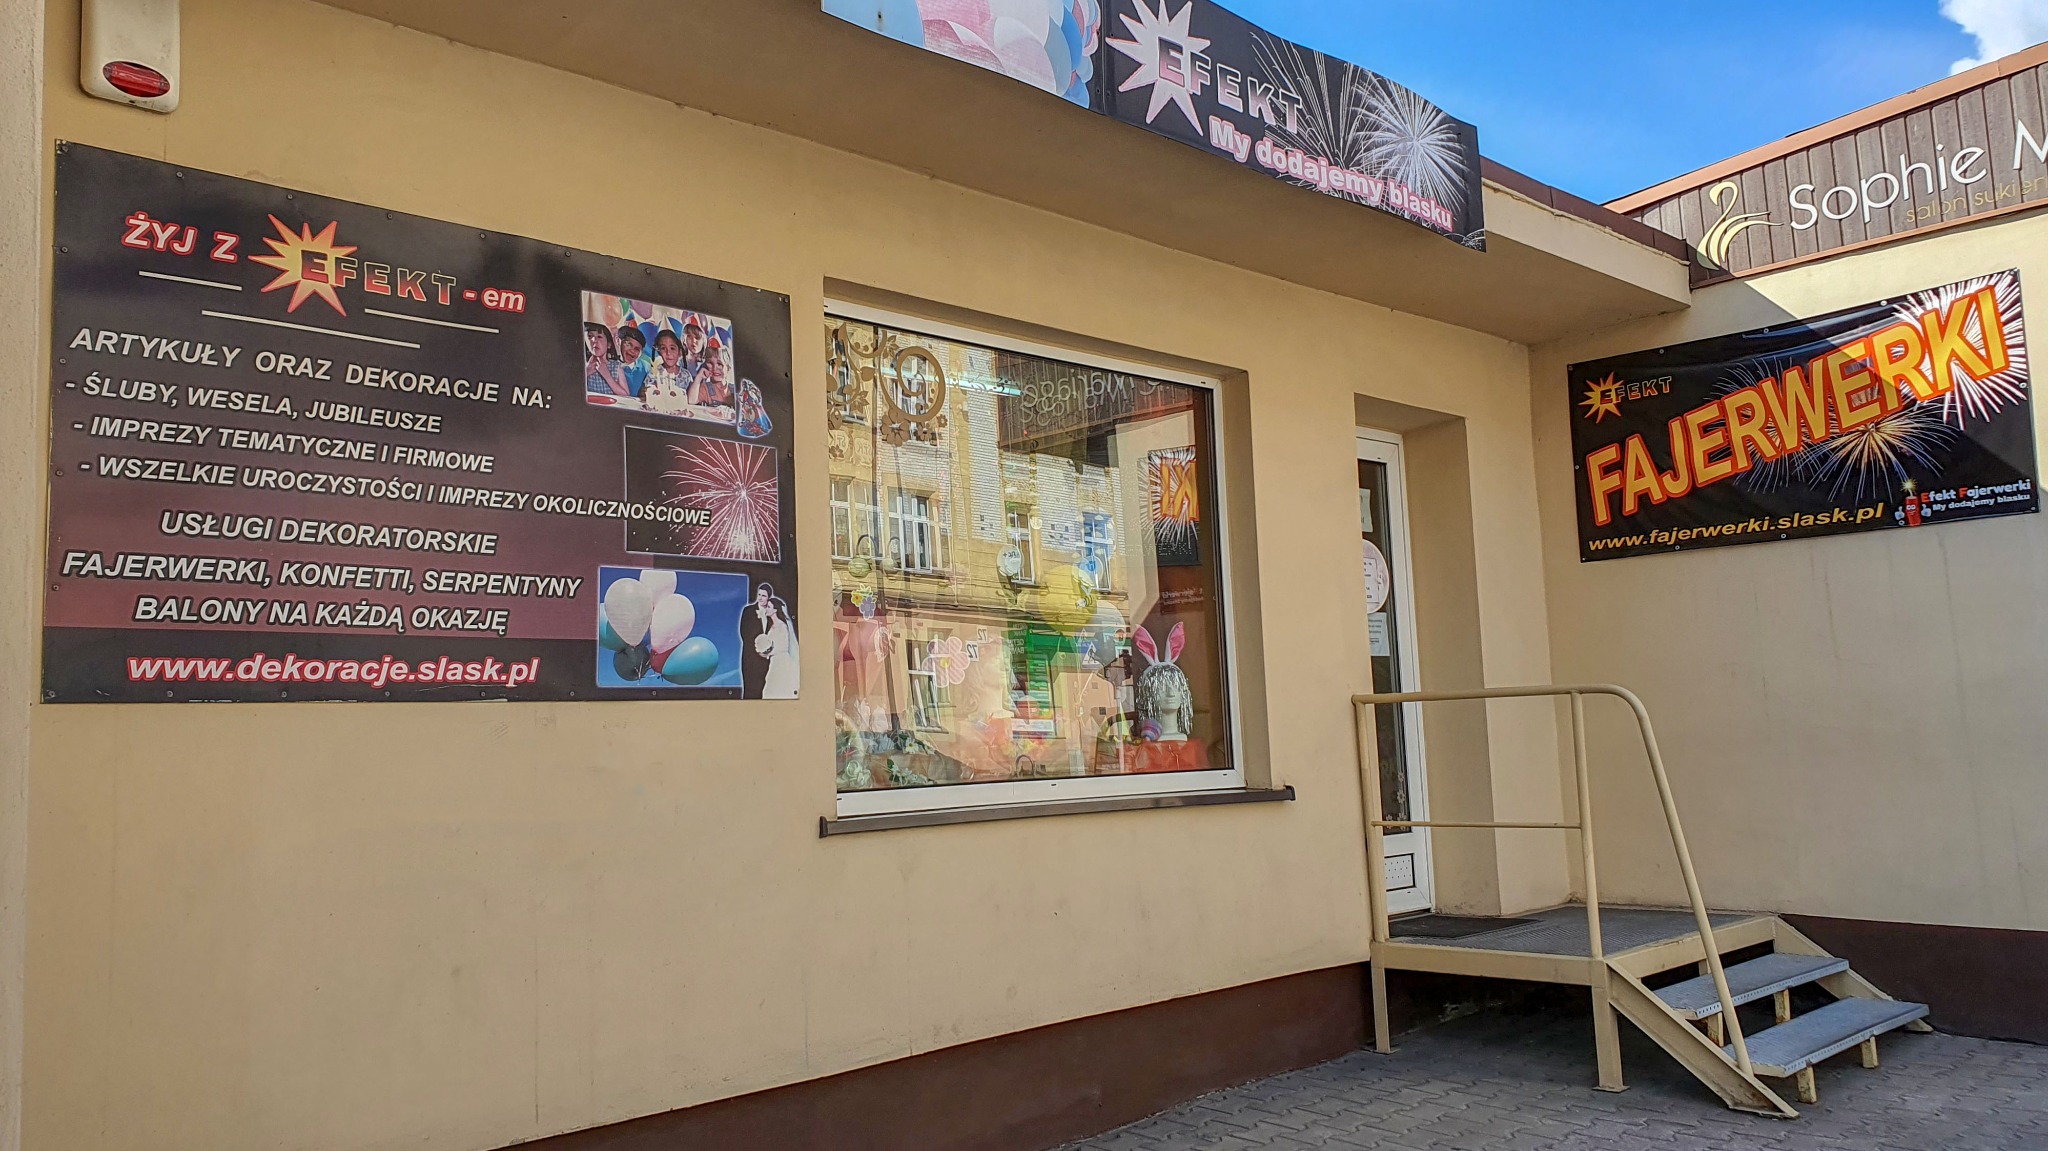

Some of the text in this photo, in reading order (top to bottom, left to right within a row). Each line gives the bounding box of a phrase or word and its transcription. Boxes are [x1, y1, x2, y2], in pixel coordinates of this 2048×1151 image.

[1158, 36, 1302, 134] EFEKT
[1208, 115, 1453, 232] My dodajemy blasku
[1788, 143, 1989, 230] Sophie
[1906, 195, 1967, 223] salon
[122, 211, 197, 255] ŻYJ
[300, 249, 457, 306] EFEKT
[69, 327, 553, 409] ARTYKUŁY ORAZ DEKORACJE NA:
[1600, 376, 1672, 404] EFEKT
[83, 371, 178, 407] ŚLUBY,
[187, 387, 298, 419] WESELA,
[305, 401, 442, 434] JUBILEUSZE
[1586, 285, 2010, 526] FAJERWERKI
[90, 416, 213, 446] IMPREZY
[218, 428, 376, 462] TEMATYCZNE
[380, 445, 389, 462] I
[393, 446, 495, 474] FIRMOWE
[99, 456, 237, 486] WSZELKIE
[242, 466, 424, 501] UROCZYSTOŚCI
[426, 484, 436, 502] I
[438, 486, 530, 511] IMPREZY
[532, 494, 711, 526] OKOLICZNOŚCIOWE
[1921, 479, 2031, 503] Efekt Fajerwerki
[1932, 494, 2030, 512] My dodajemy blasku
[161, 511, 498, 554] USŁUGI DEKORATORSKIE
[1589, 502, 1884, 552] www.fajerwerki.slask.pl
[62, 551, 582, 598] FAJERWERKI, KONFETTI, SERPENTYNY
[134, 596, 508, 635] BALONY NA KAŻDĄ OKAZJĘ
[128, 653, 540, 688] www.dekoracje.slask.pl
